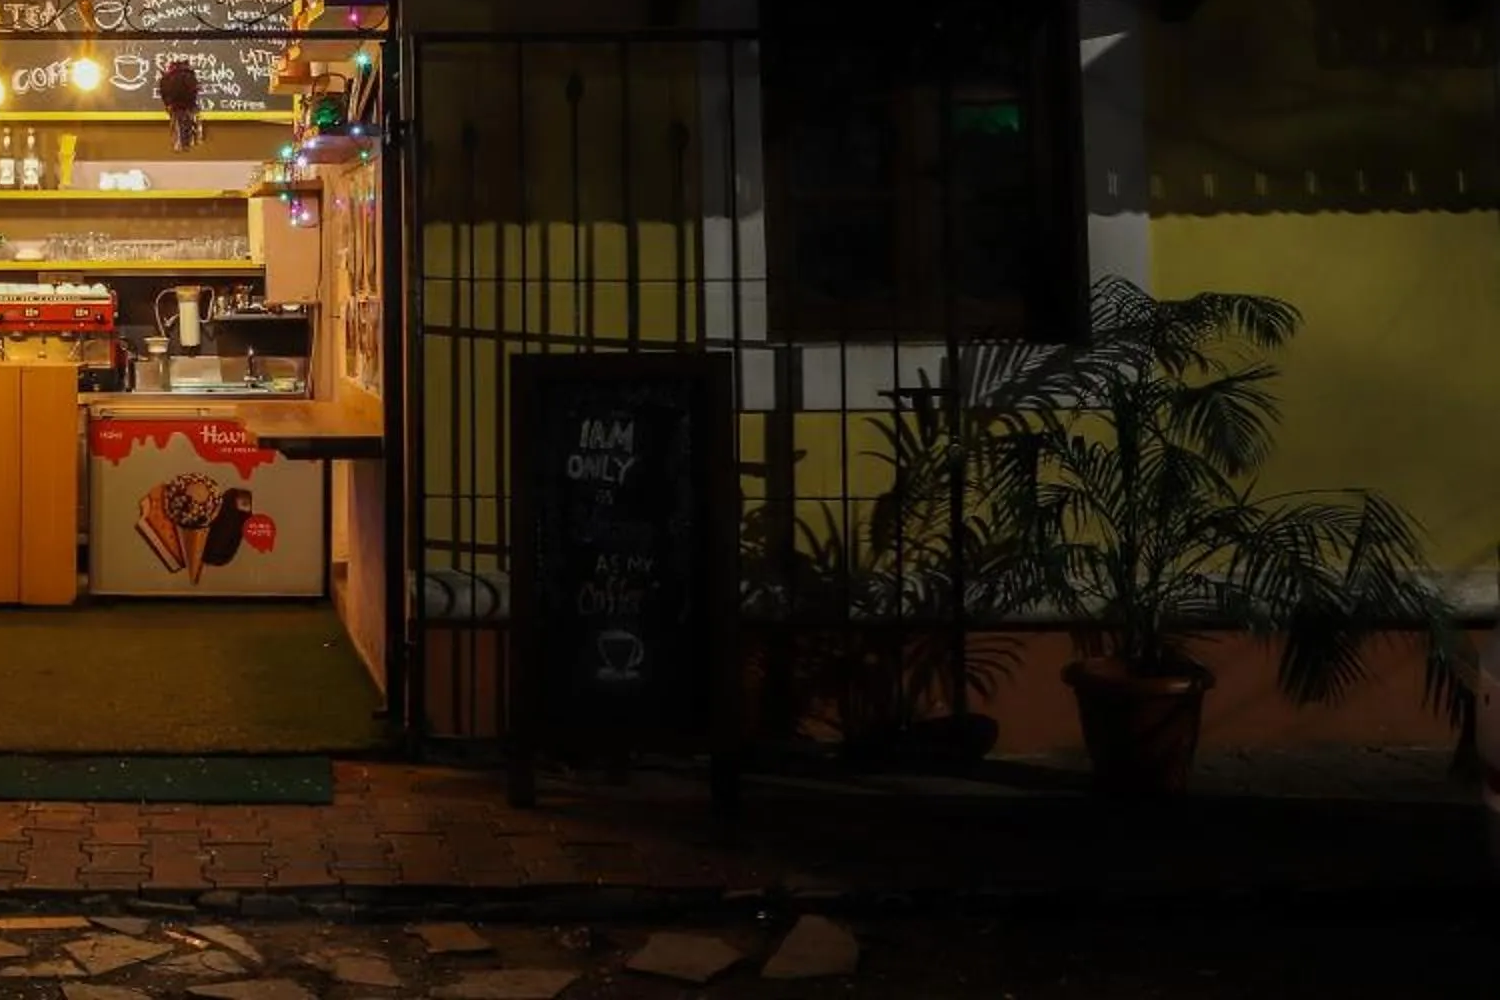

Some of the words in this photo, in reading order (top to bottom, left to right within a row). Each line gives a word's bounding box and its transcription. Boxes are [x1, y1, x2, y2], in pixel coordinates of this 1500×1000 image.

[4, 1, 67, 32] TEA
[11, 57, 85, 95] COFF
[567, 454, 637, 487] ONLY
